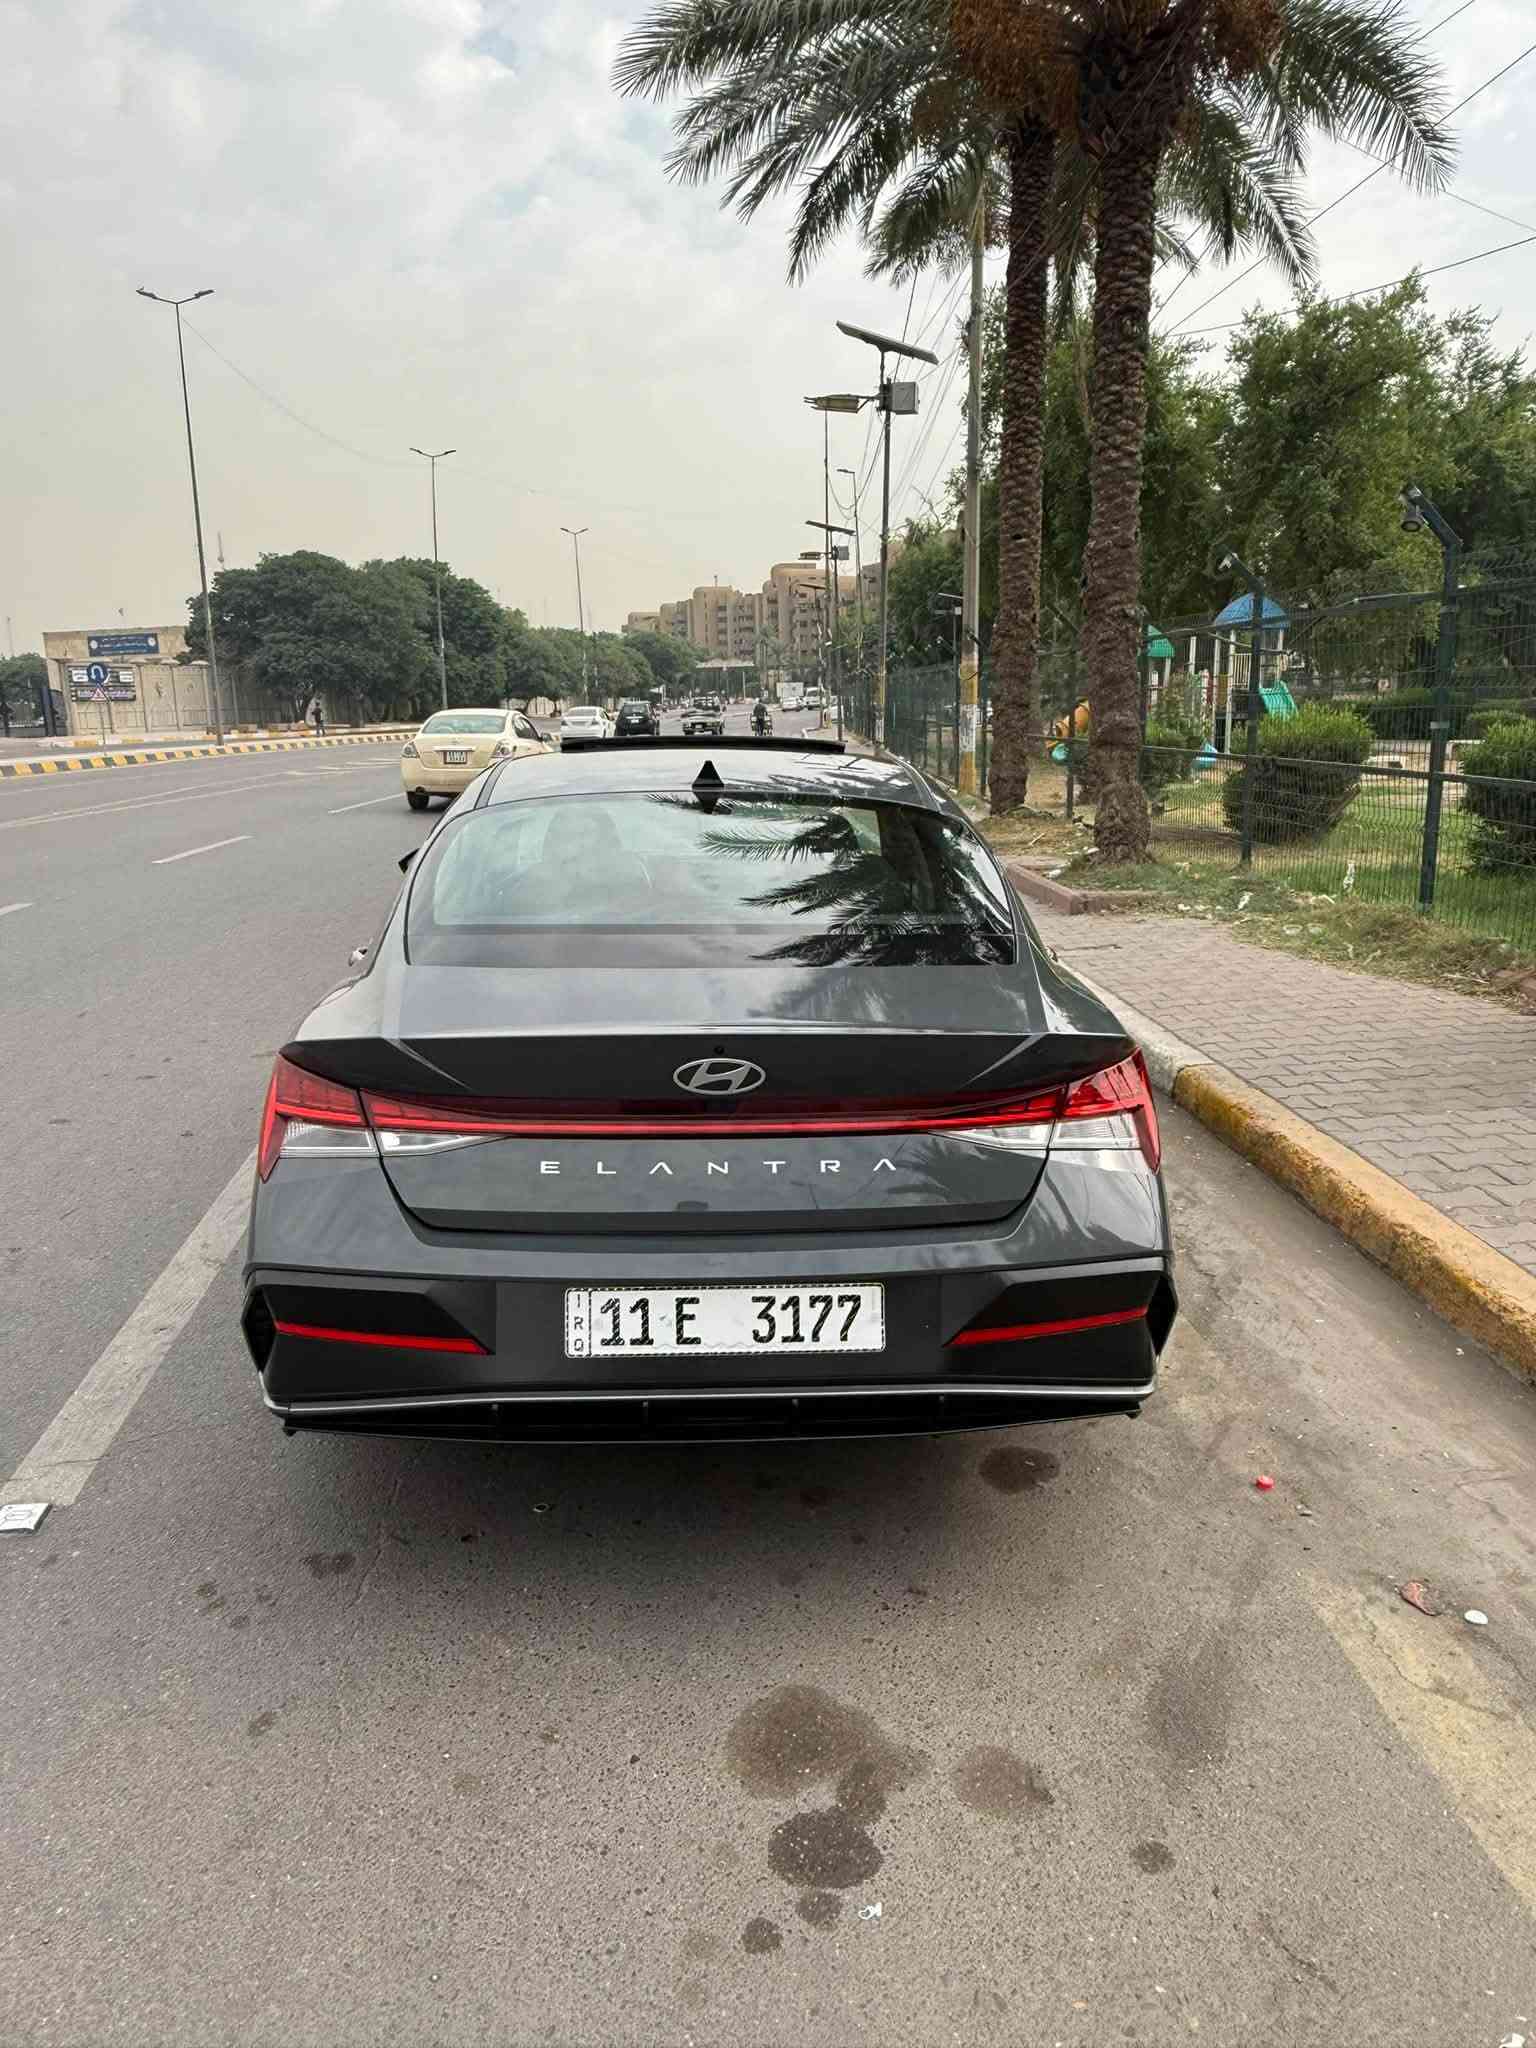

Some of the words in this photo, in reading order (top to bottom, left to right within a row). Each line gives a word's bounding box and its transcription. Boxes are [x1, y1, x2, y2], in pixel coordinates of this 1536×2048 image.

[540, 1158, 896, 1175] ELANTRA
[574, 1293, 584, 1352] IRQ
[600, 1297, 654, 1346] 11
[675, 1297, 701, 1345] E
[752, 1295, 862, 1344] 3177
